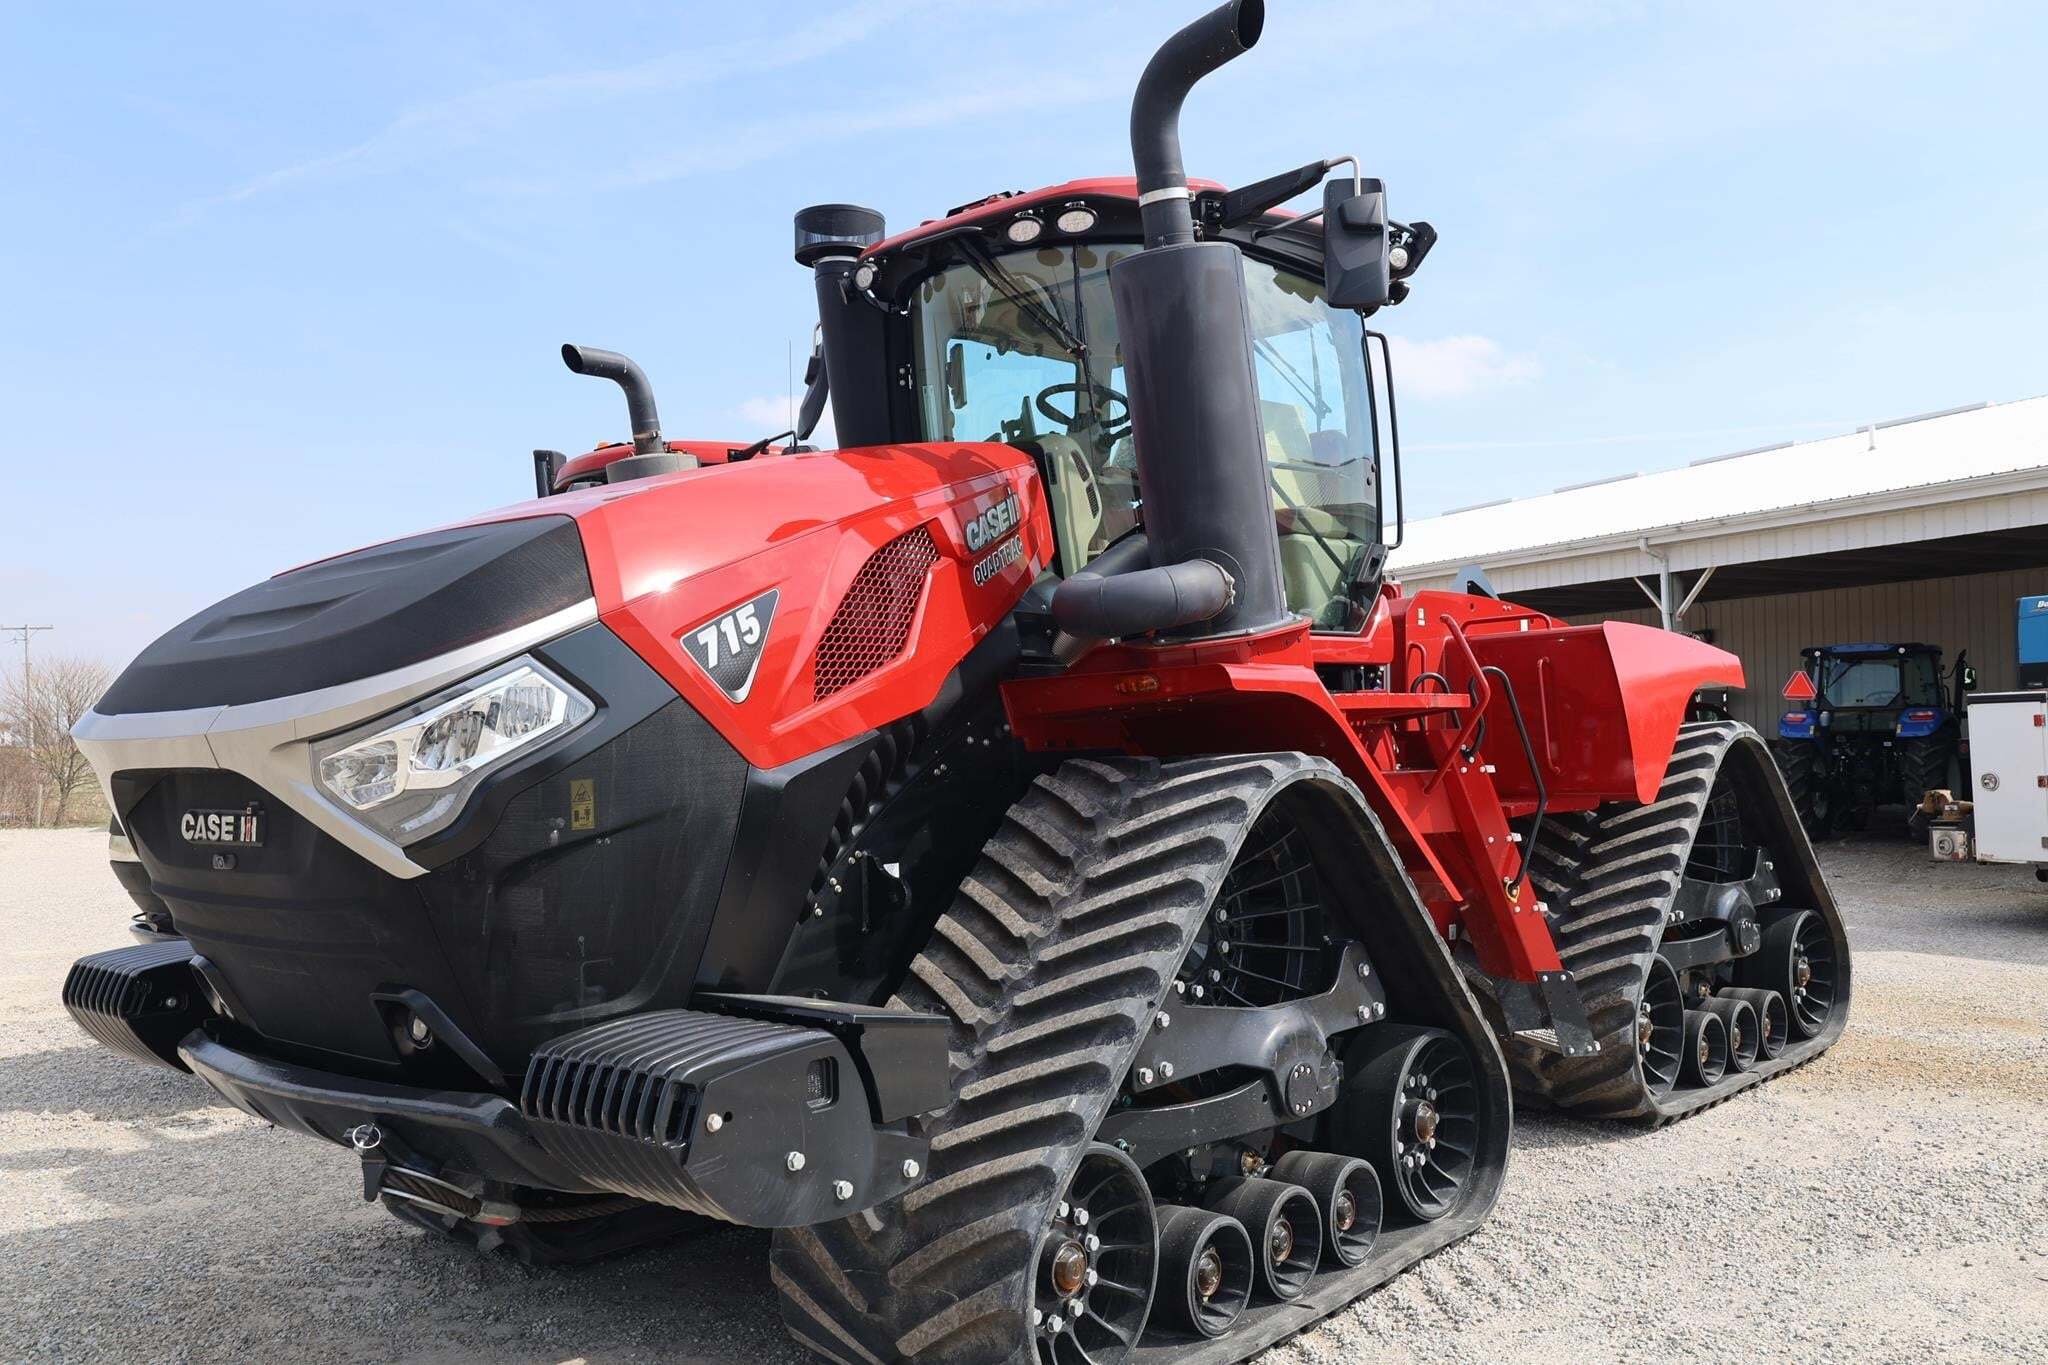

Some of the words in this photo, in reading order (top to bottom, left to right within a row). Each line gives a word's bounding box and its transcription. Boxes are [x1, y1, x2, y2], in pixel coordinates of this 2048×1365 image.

[967, 502, 1010, 551] CASE
[973, 534, 1024, 587] QUADTRAC
[697, 603, 761, 669] 715
[181, 813, 235, 841] CASE
